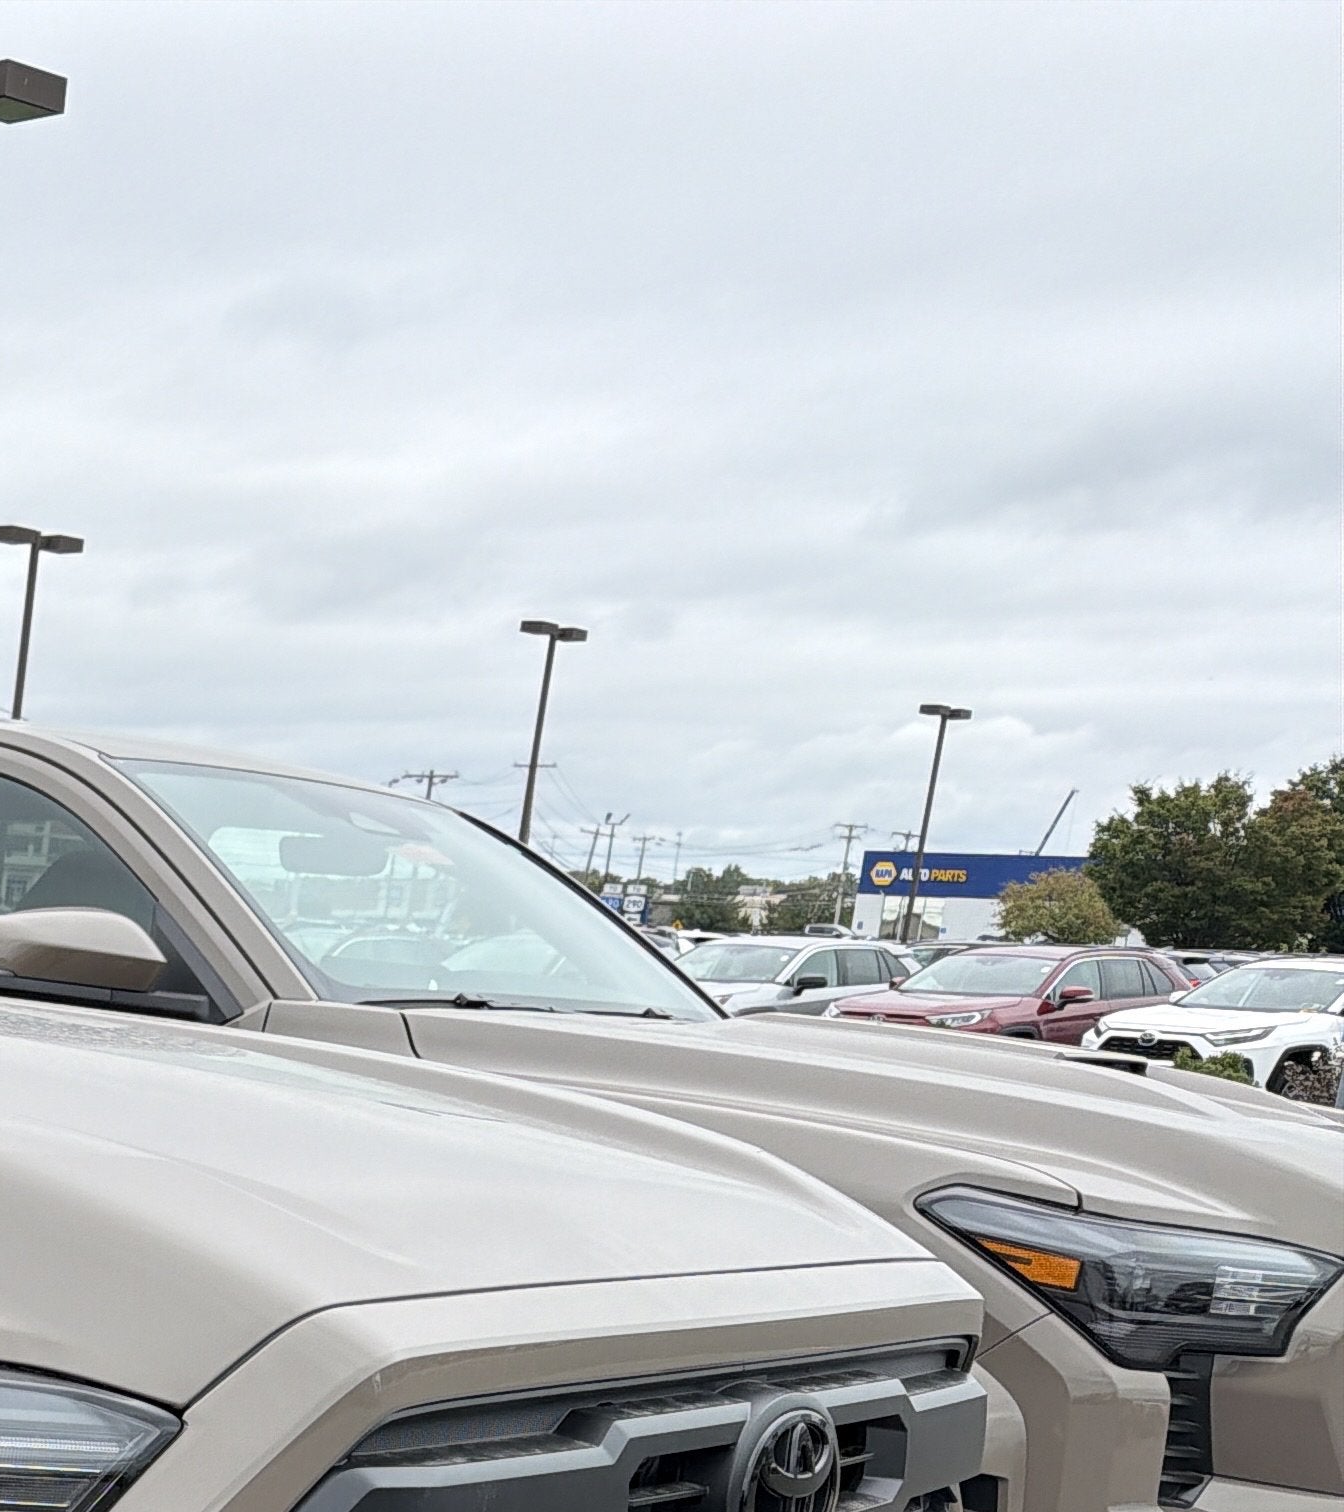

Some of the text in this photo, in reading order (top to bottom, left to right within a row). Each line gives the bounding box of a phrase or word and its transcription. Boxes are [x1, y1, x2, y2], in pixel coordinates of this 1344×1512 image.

[899, 867, 930, 882] AUO
[930, 869, 968, 883] PARTS
[626, 899, 643, 909] 290
